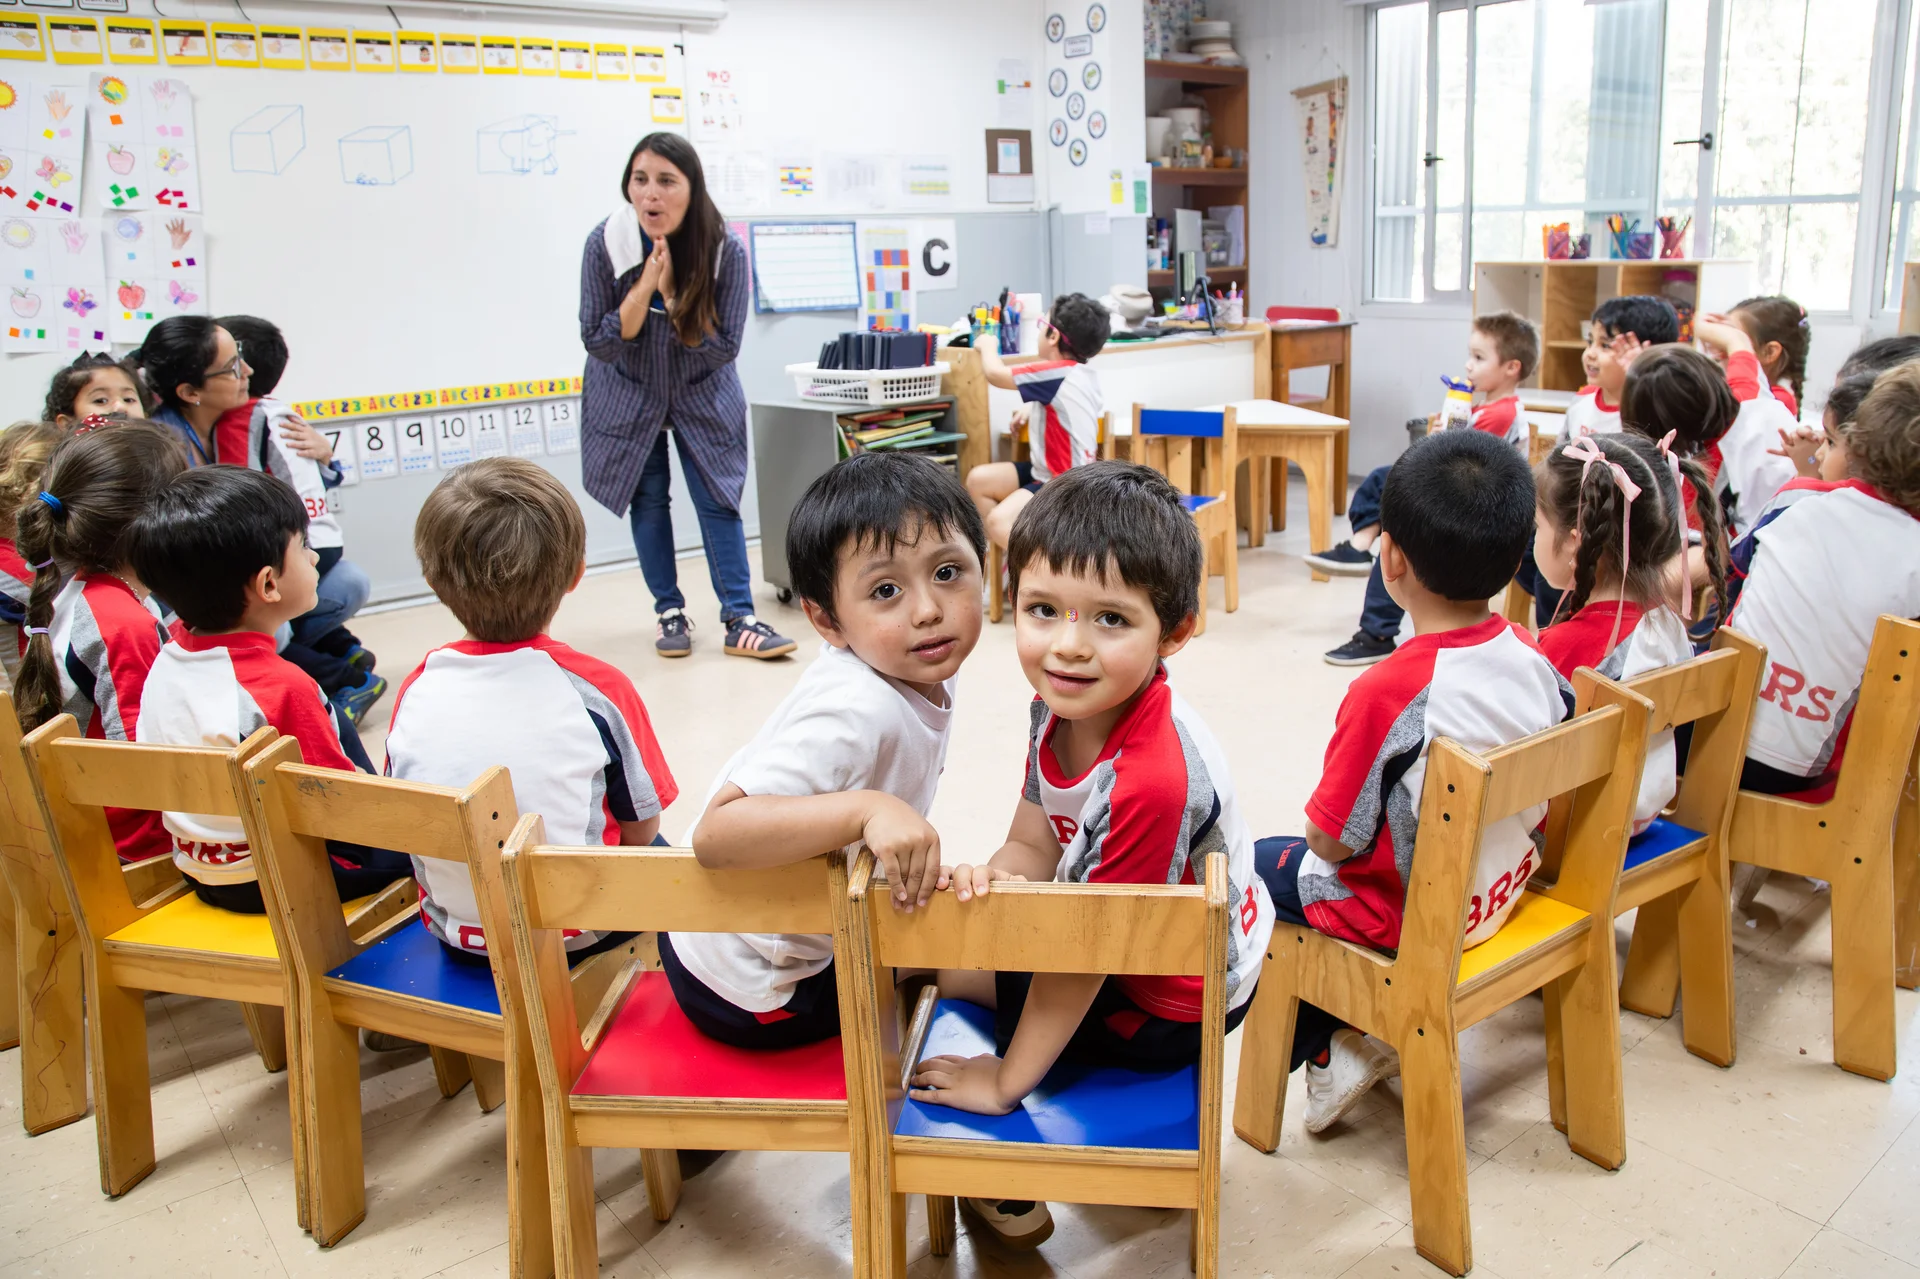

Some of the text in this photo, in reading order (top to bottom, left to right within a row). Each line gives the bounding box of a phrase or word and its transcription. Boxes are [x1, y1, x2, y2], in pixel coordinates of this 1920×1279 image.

[922, 239, 951, 277] C
[325, 403, 570, 453] 7 8 9 10 11 12 13
[1759, 661, 1837, 722] RS
[1465, 845, 1536, 935] BRS
